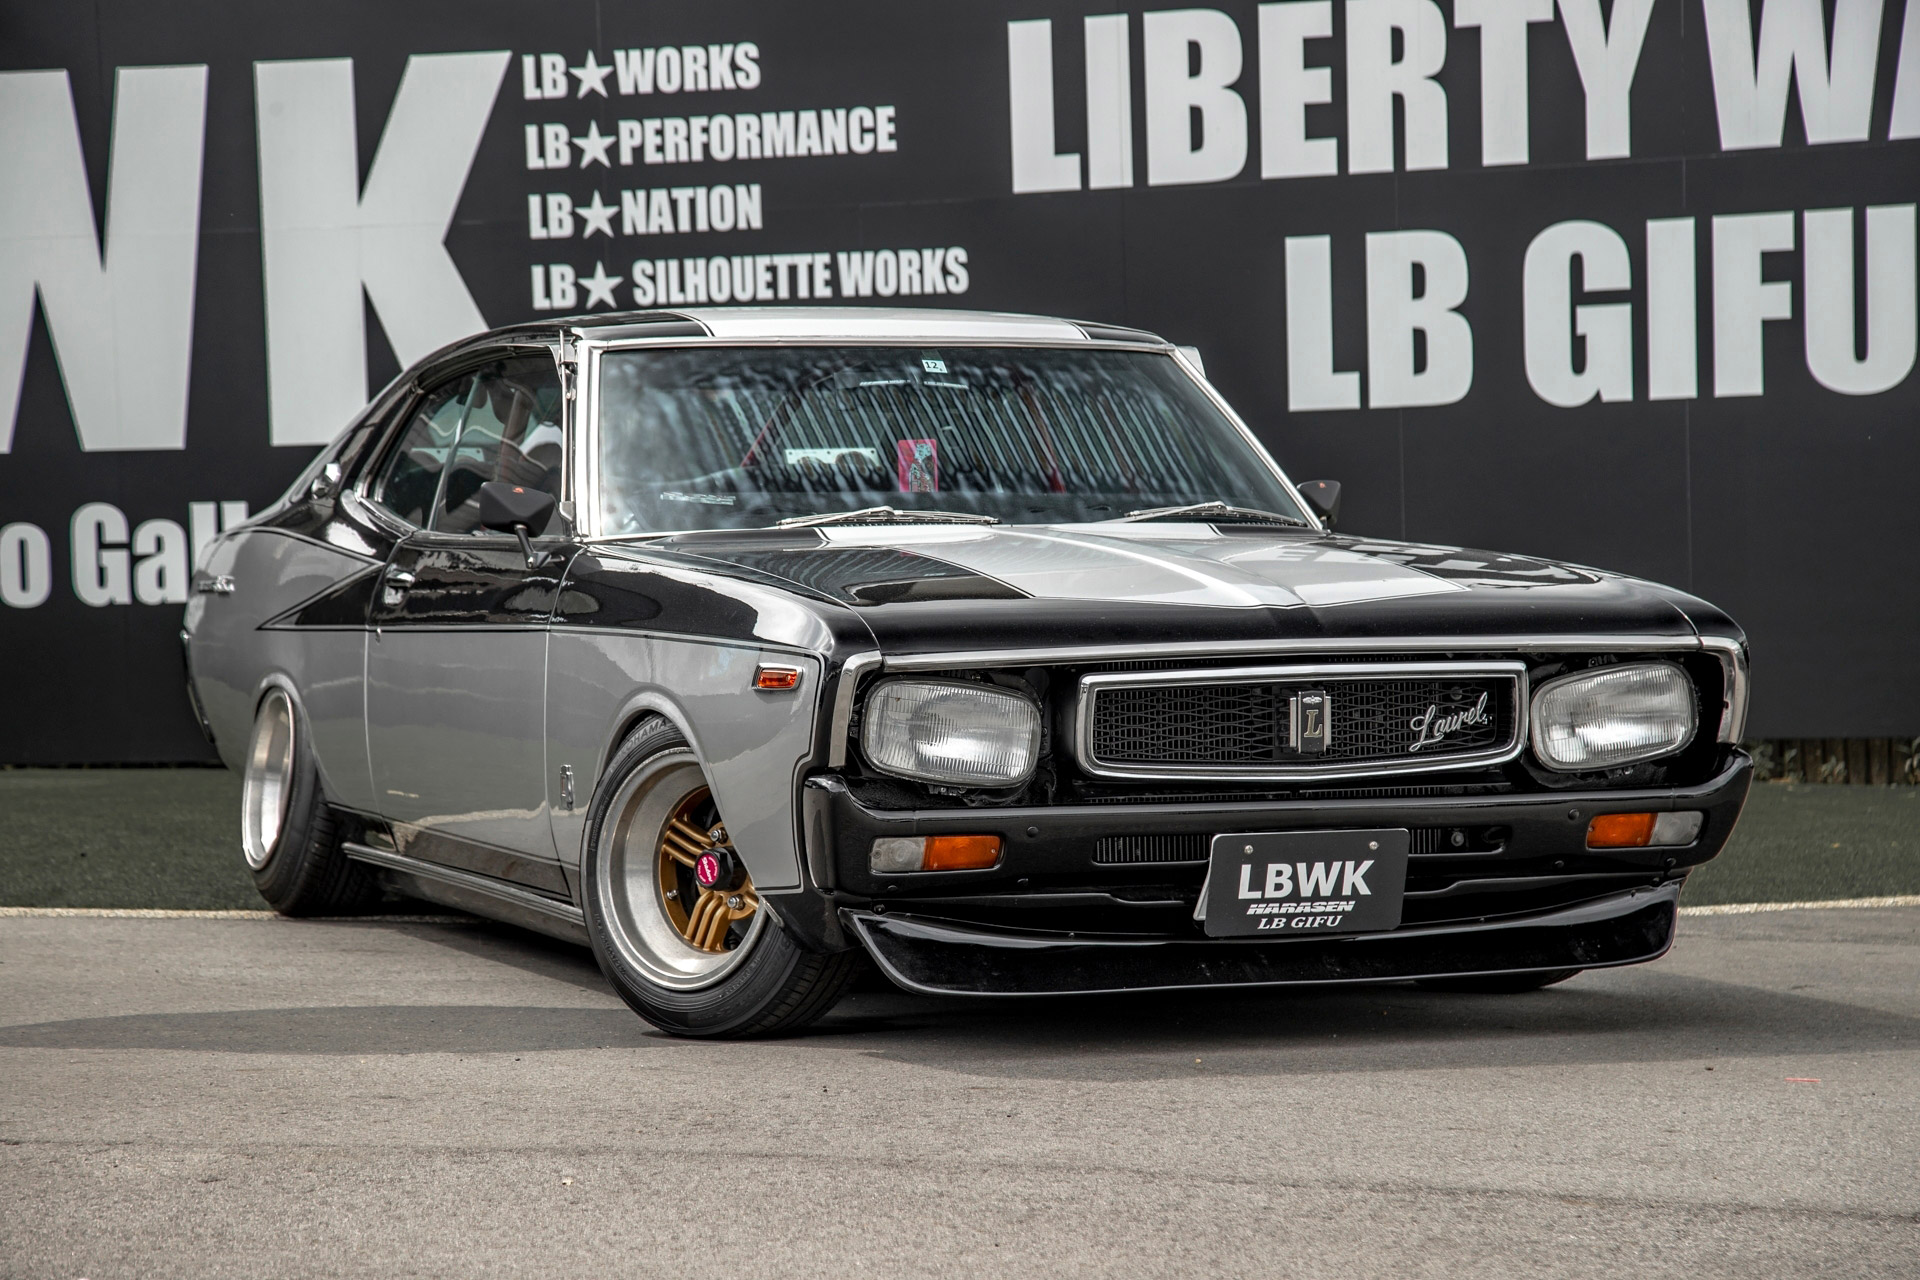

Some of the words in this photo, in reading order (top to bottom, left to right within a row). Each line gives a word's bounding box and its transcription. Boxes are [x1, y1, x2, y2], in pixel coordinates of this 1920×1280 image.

[1008, 0, 1655, 194] LIBERTY
[633, 252, 832, 305] SILHOUETTE
[837, 247, 969, 298] WORKS
[1285, 230, 1473, 412] LB
[1523, 204, 1917, 407] GIFU
[1304, 710, 1323, 737] L
[1409, 691, 1488, 752] Laurel
[1238, 860, 1375, 900] LBWK
[1246, 901, 1356, 915] HARASEN
[1257, 918, 1287, 929] LB
[1291, 915, 1343, 928] GIFU
